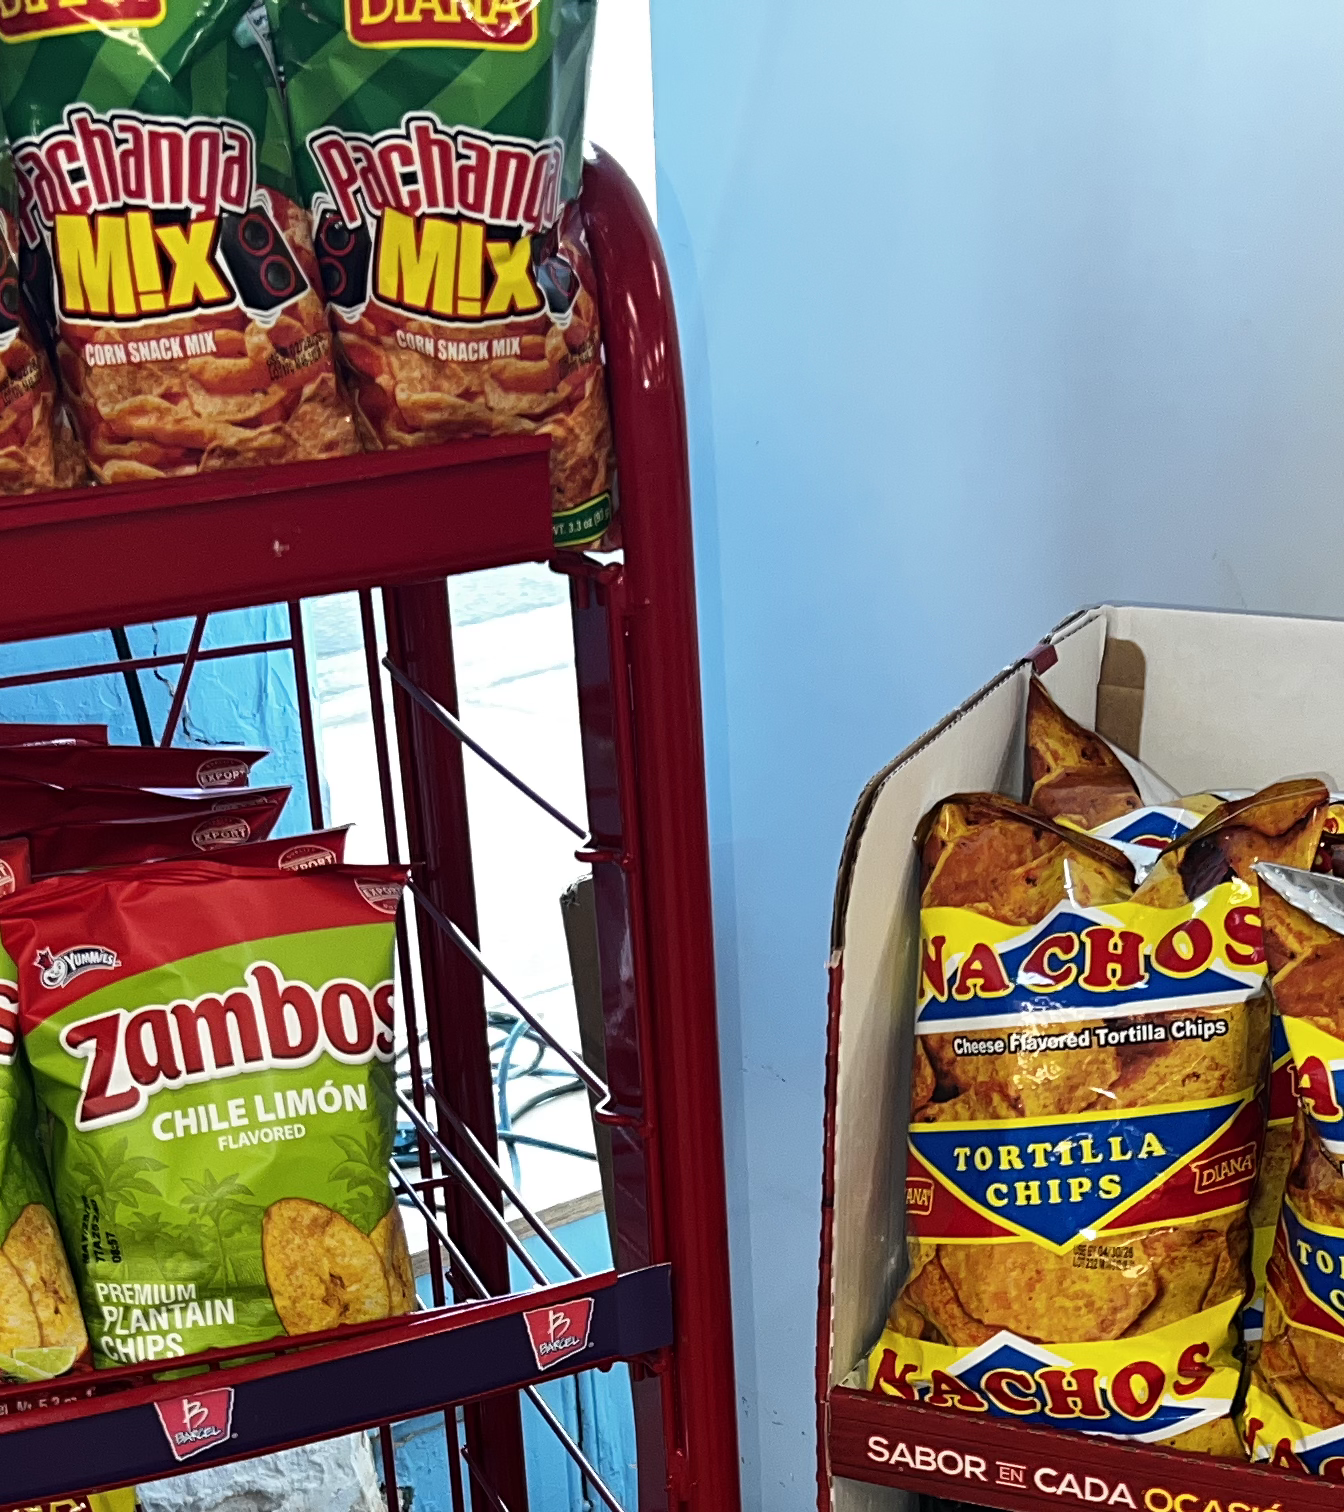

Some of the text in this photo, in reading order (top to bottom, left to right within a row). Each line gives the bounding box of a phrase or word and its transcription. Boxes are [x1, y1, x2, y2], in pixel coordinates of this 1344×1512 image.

[86, 331, 216, 367] CORN SNACK MIX
[396, 331, 520, 361] CORN SNACK MIX
[194, 826, 248, 845] EXPORT
[920, 905, 1265, 1003] NACHOS
[953, 1017, 1229, 1057] Cheese Flavored Tortilla Chips
[152, 1079, 369, 1142] CHILE LIMÓN
[218, 1123, 307, 1152] FLAVORED
[953, 1134, 1167, 1173] TORTILLA
[1202, 1154, 1254, 1189] DIANA
[985, 1174, 1123, 1208] CHIPS
[94, 1282, 198, 1306] PREMIUM
[101, 1297, 236, 1333] PLANTAIN
[100, 1333, 184, 1364] CHIPS
[872, 1342, 1214, 1420] NACHOS
[867, 1435, 988, 1483] SABOR
[998, 1464, 1026, 1487] EN
[1033, 1466, 1137, 1511] CADA
